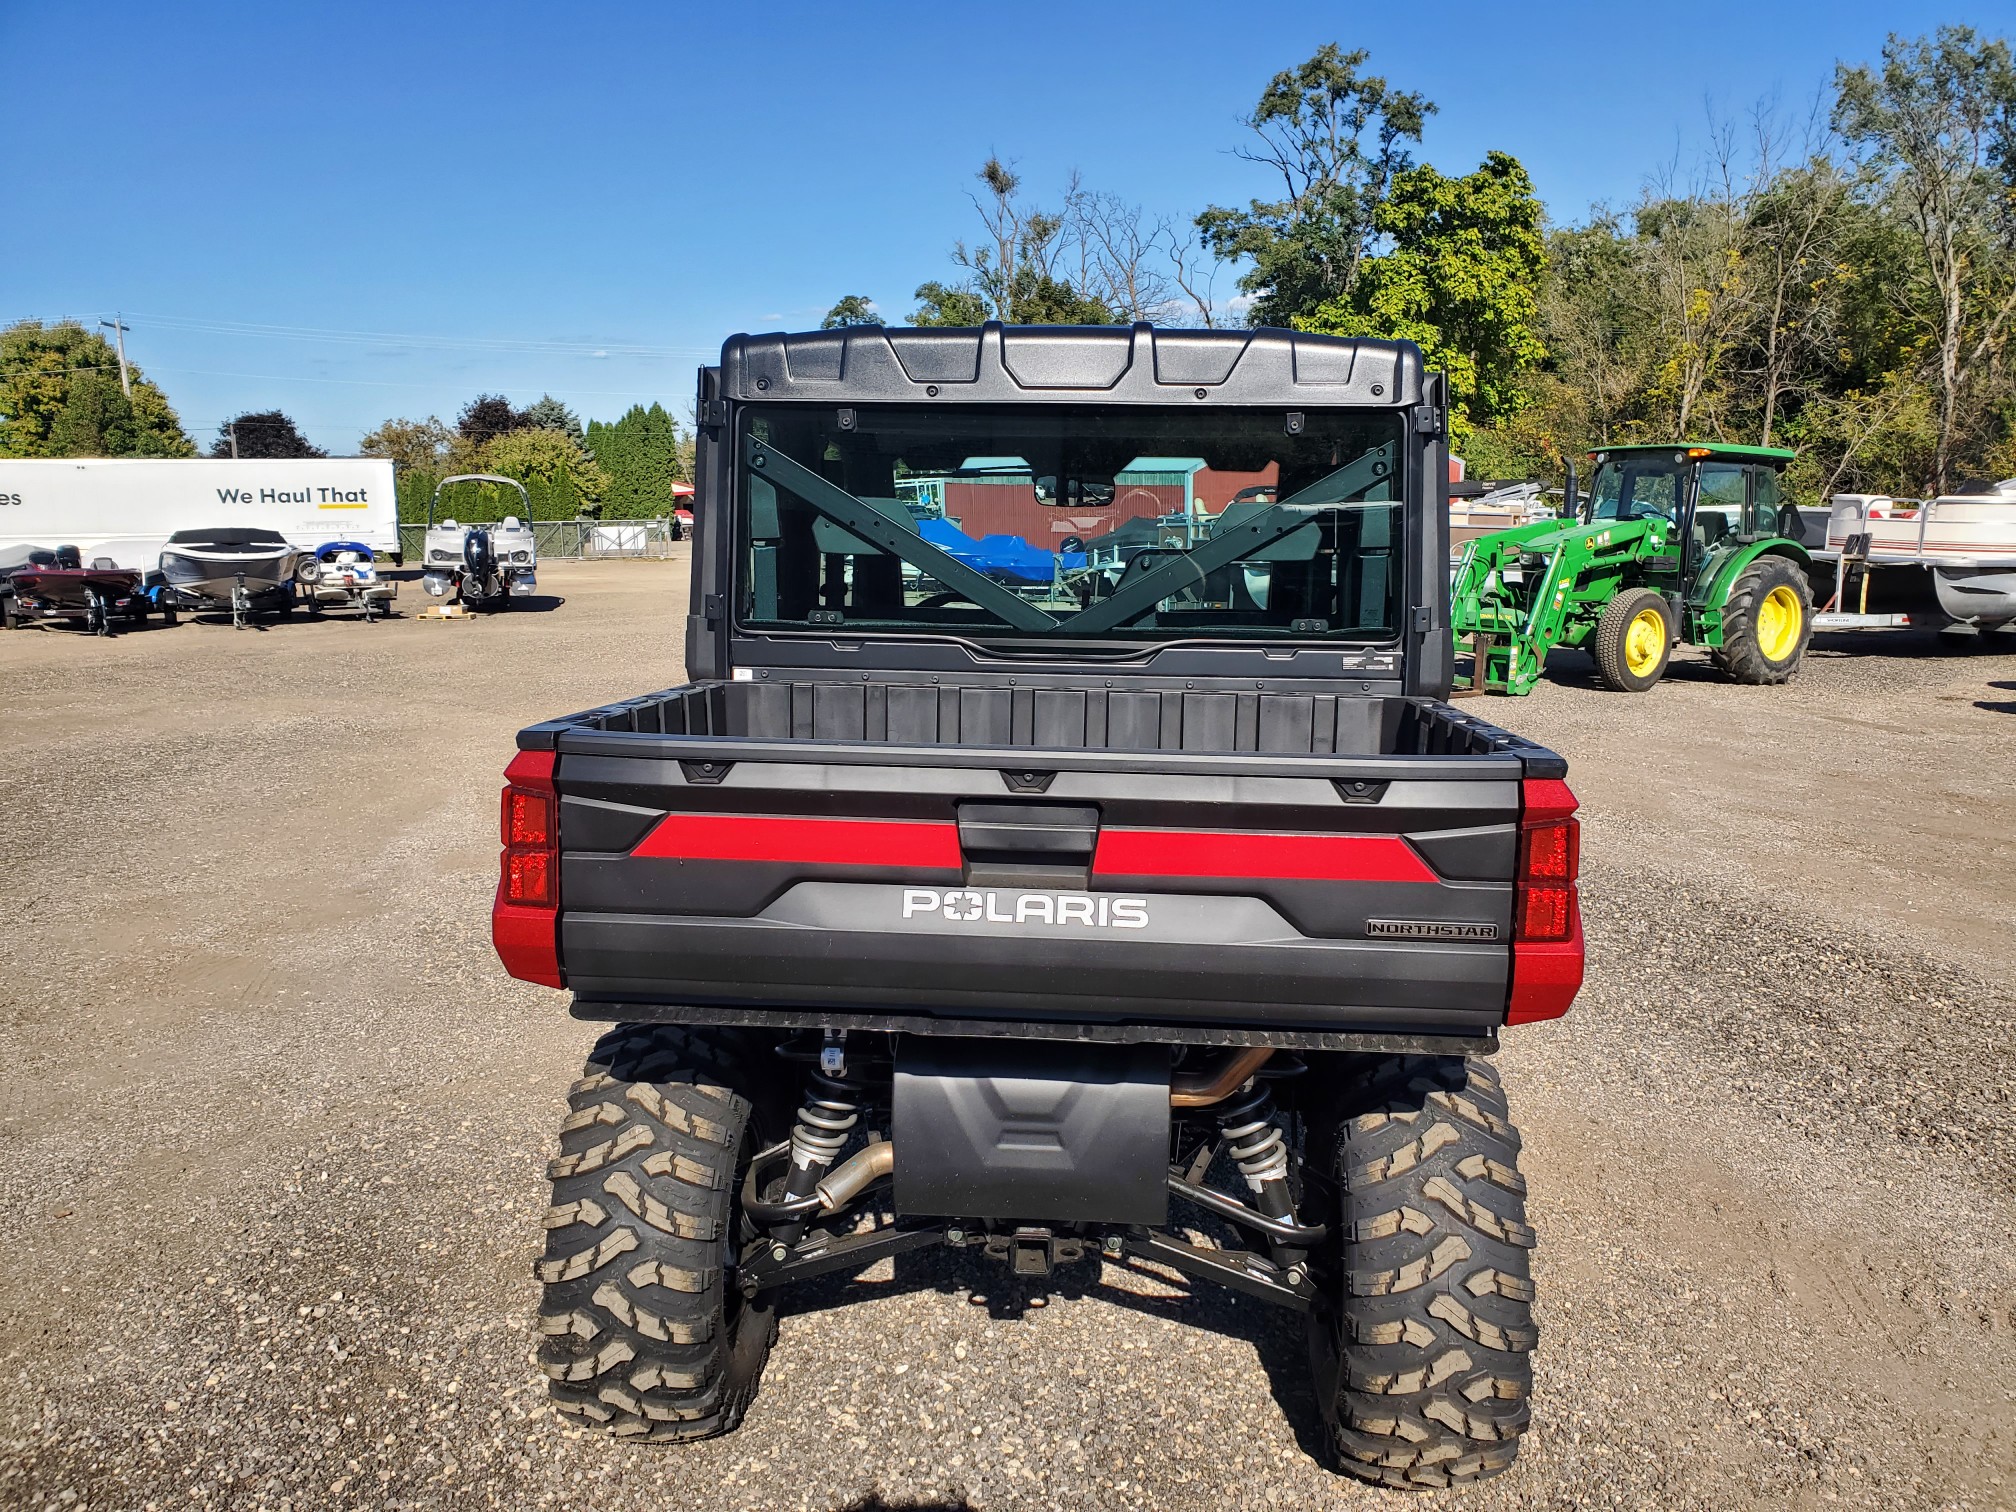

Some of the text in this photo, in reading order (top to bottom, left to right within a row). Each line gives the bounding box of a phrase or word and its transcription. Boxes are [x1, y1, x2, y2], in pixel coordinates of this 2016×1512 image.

[216, 487, 368, 504] We Haul That
[902, 888, 1150, 929] POLARIS
[1372, 923, 1494, 937] NORTHSTAR
